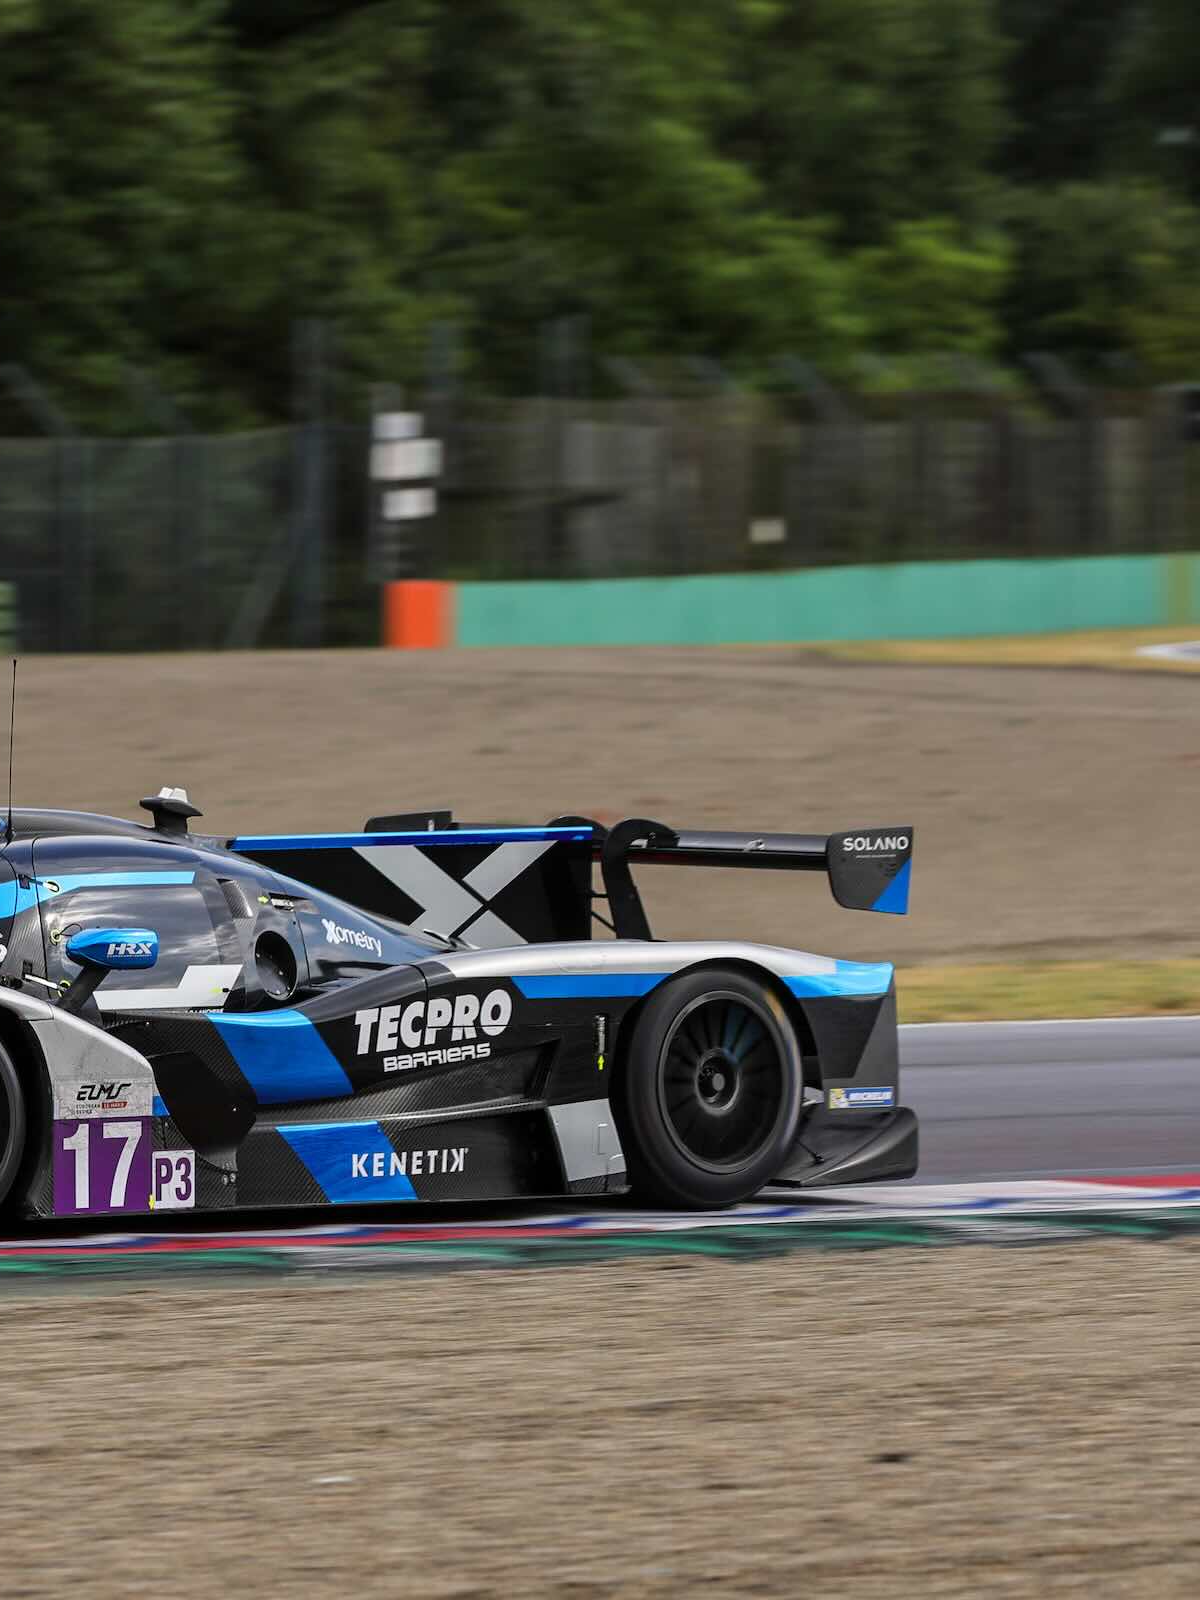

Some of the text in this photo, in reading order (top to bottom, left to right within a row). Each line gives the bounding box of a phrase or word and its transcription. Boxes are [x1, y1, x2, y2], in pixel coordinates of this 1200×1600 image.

[842, 836, 909, 851] SOLANO
[107, 943, 153, 955] HRX
[322, 918, 382, 957] Xometry
[354, 989, 513, 1055] TECPRO
[383, 1042, 491, 1073] BARRIERS
[63, 1121, 142, 1209] 17
[156, 1157, 192, 1201] P3
